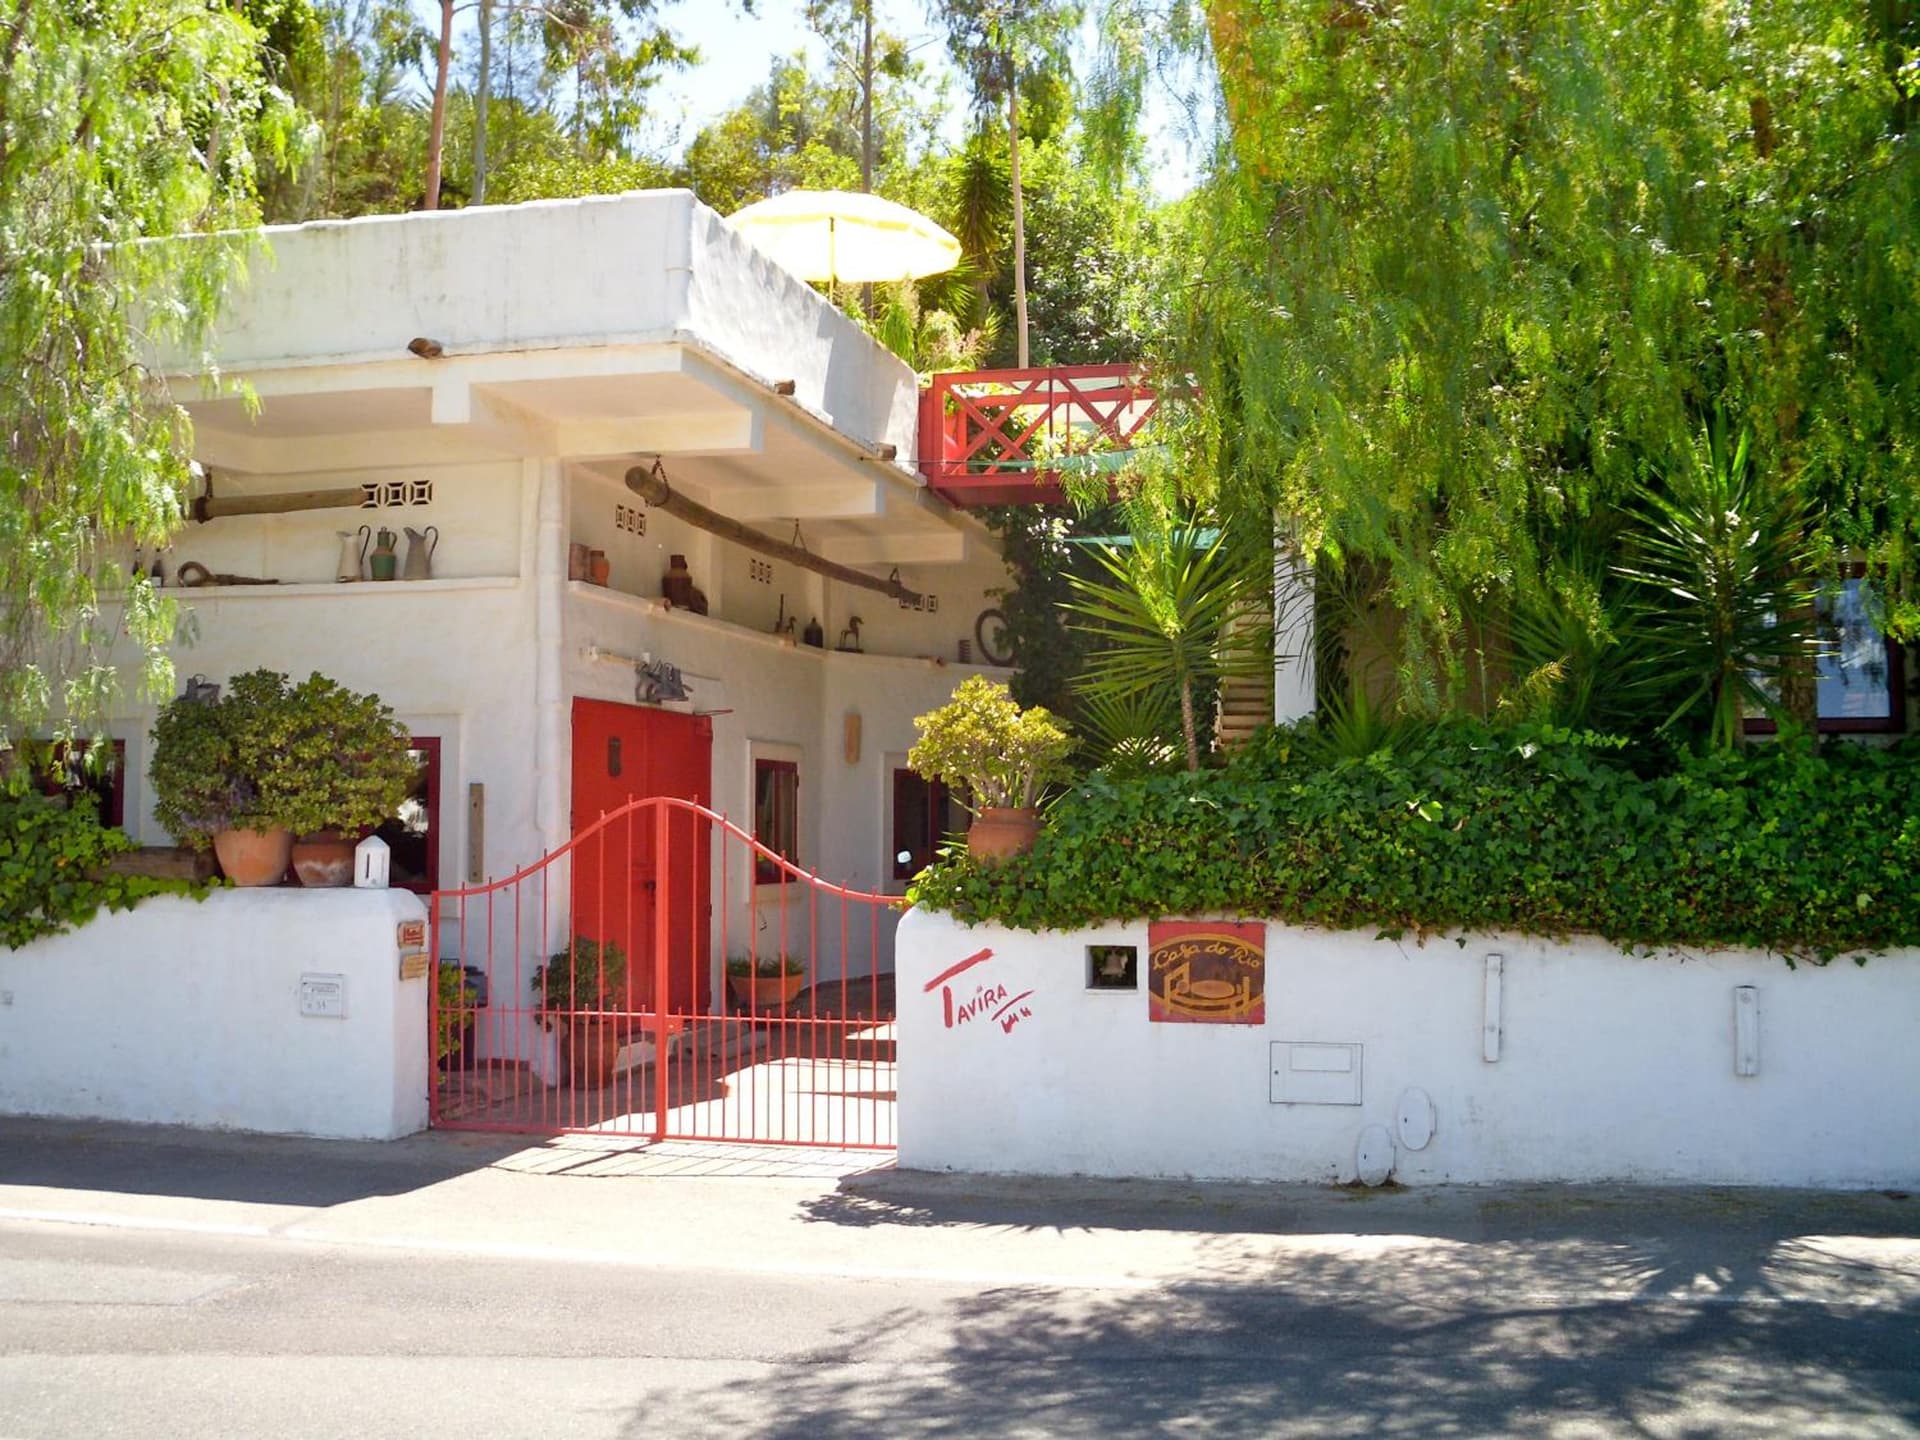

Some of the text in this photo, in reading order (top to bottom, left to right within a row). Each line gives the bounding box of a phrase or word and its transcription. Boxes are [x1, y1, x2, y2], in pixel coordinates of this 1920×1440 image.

[1153, 941, 1261, 970] Casa do Rio
